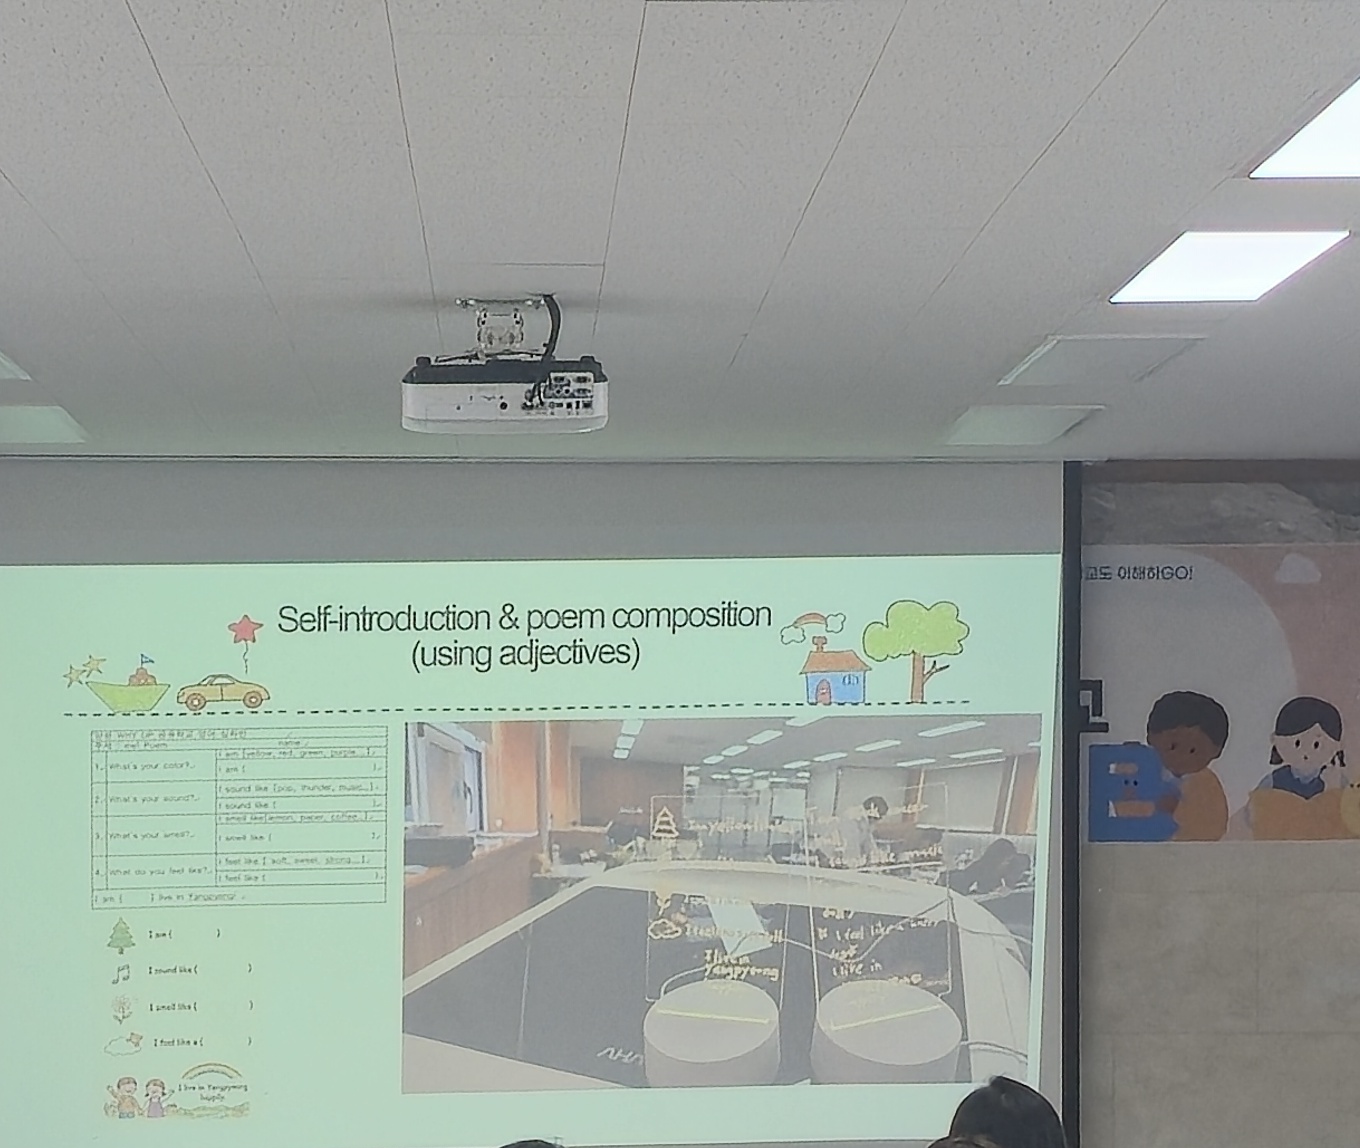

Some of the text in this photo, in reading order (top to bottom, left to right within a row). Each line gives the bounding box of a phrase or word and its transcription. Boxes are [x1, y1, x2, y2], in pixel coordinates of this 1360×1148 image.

[1117, 565, 1193, 580] 이해하GO!
[277, 600, 773, 636] Self-introduction & poem composition
[411, 637, 642, 673] (using adjectives)
